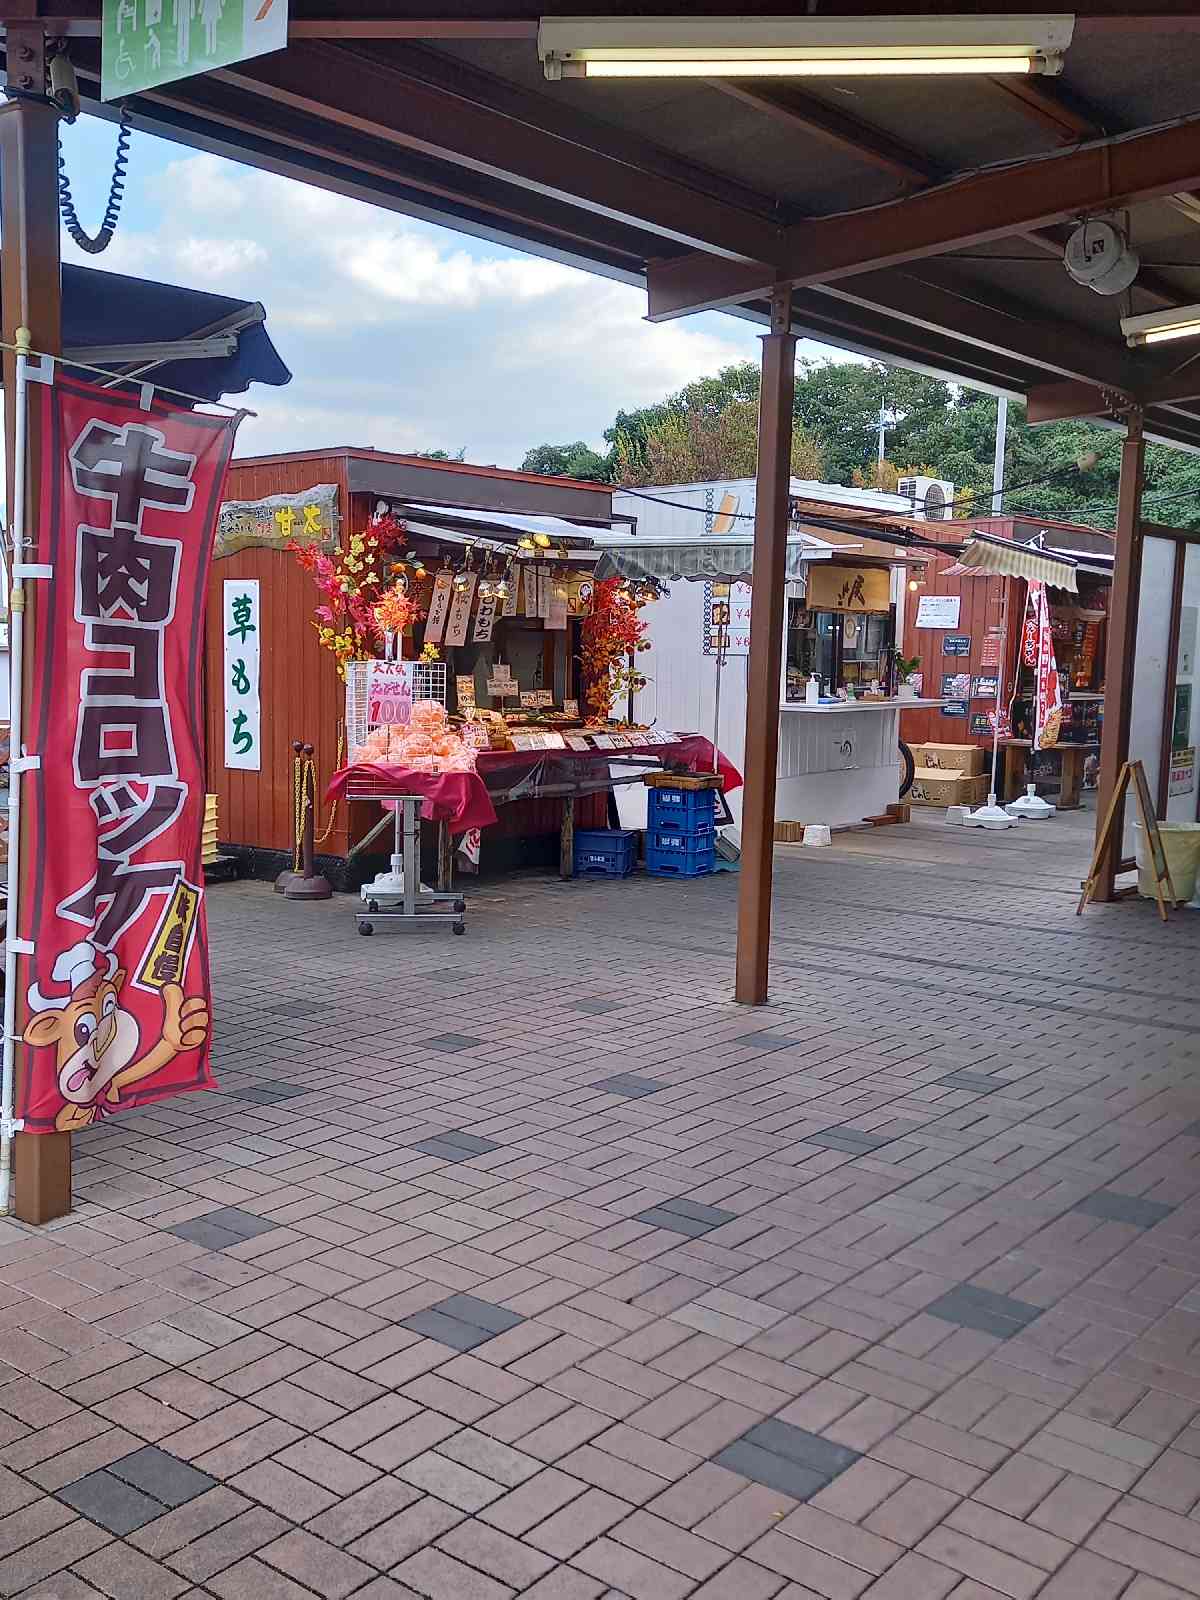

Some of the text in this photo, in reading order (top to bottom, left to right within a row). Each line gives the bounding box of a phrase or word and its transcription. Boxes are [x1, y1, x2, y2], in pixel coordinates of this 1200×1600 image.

[57, 418, 198, 951] 牛肉コロッケ
[227, 593, 257, 755] 草もち
[371, 678, 411, 697] えびせん
